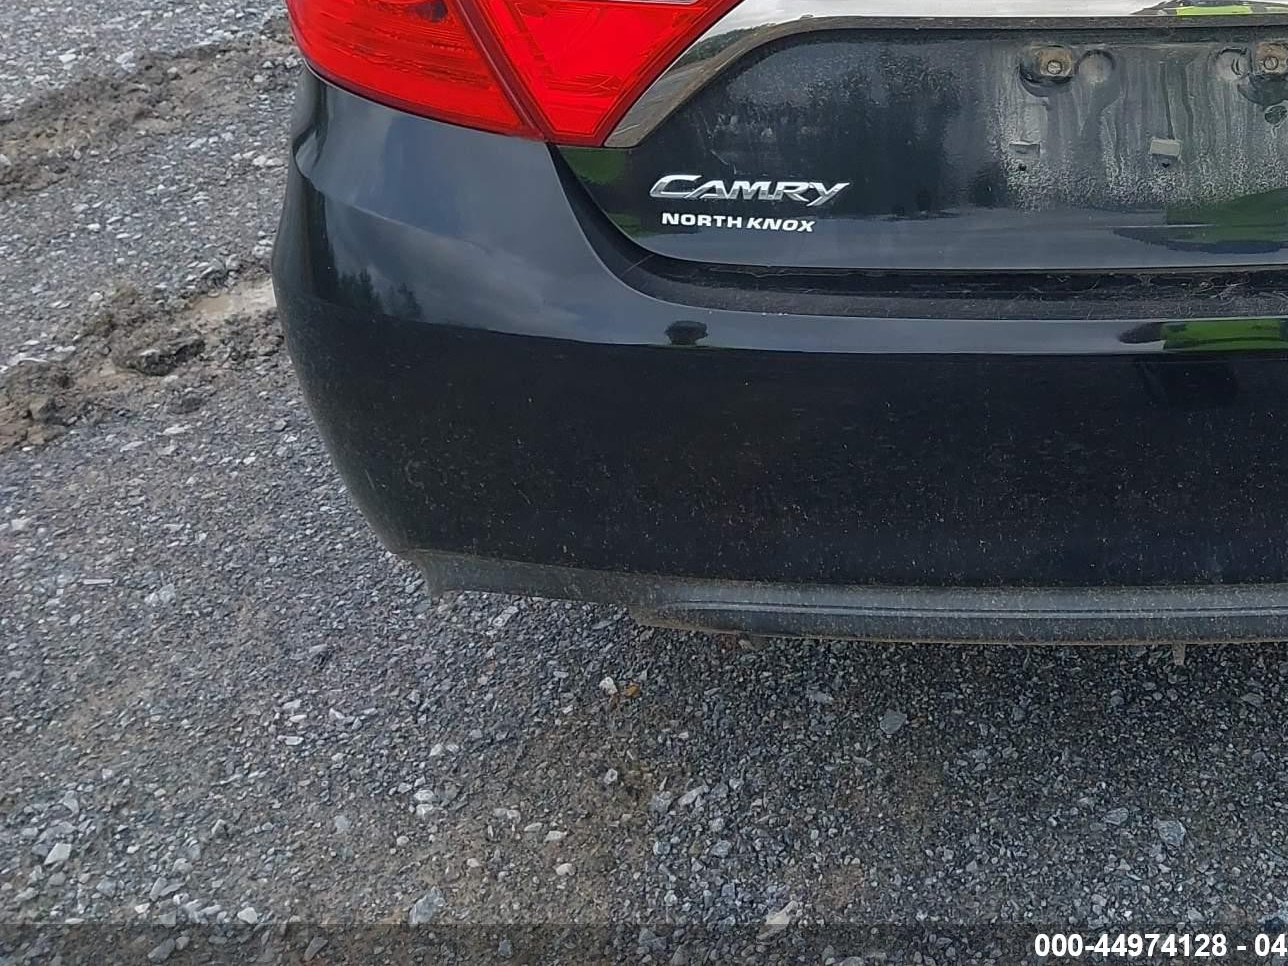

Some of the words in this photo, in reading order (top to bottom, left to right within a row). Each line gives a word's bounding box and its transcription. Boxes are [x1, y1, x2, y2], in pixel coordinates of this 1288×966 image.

[650, 174, 850, 207] CAMRY
[661, 212, 742, 228] NORTH
[746, 217, 816, 232] KNOX
